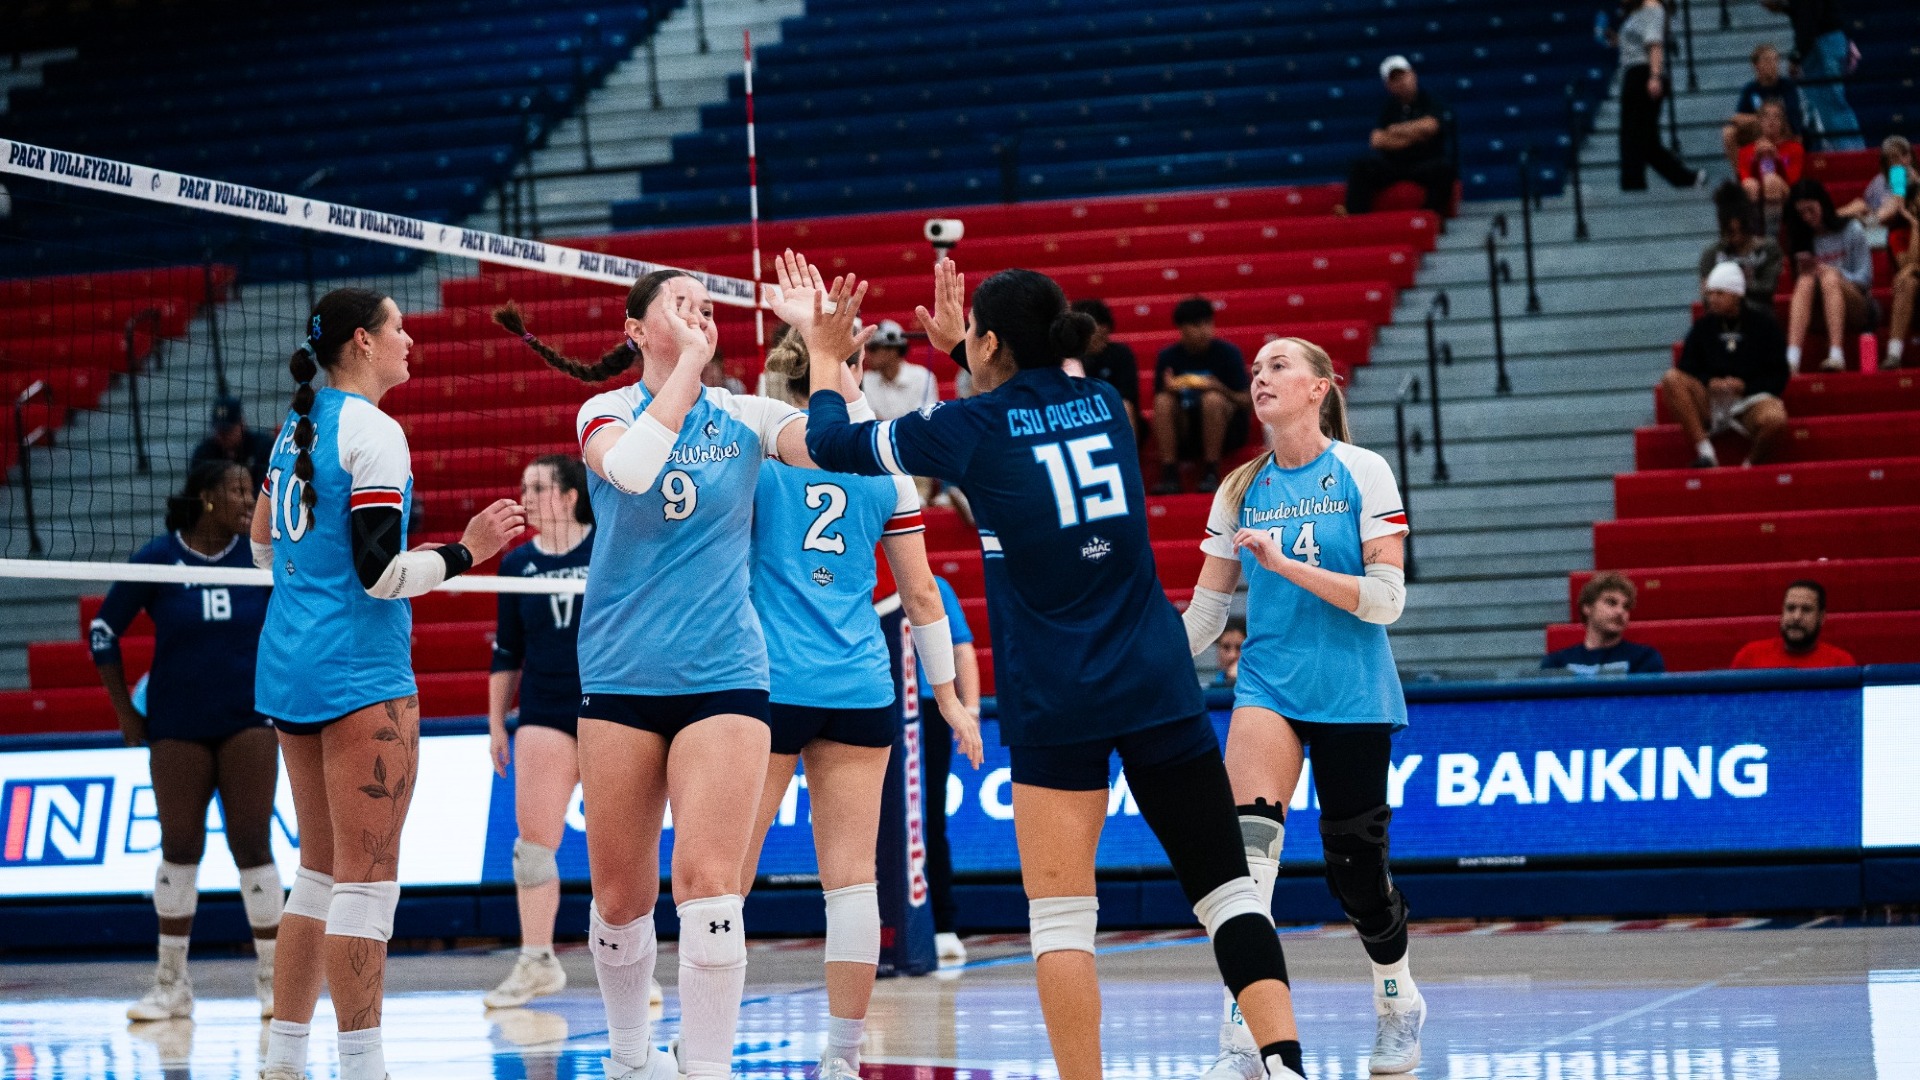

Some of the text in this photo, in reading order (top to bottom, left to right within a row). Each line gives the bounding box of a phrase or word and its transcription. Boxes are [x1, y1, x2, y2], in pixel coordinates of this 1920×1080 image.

[8, 142, 133, 187] PACK VOLLEYBALL
[177, 177, 288, 215] PACK VOLLEYBALL
[328, 203, 424, 240] PACK VOLLEYBALL
[460, 230, 546, 262] PACK VOLLEYBALL
[1008, 394, 1113, 437] CSU PUEBLO
[659, 469, 699, 522] 9
[1031, 433, 1130, 529] 15
[269, 467, 310, 543] 10
[802, 482, 848, 555] 2
[1082, 542, 1111, 557] RMAC
[203, 588, 231, 621] 18
[1436, 744, 1768, 807] BANKING
